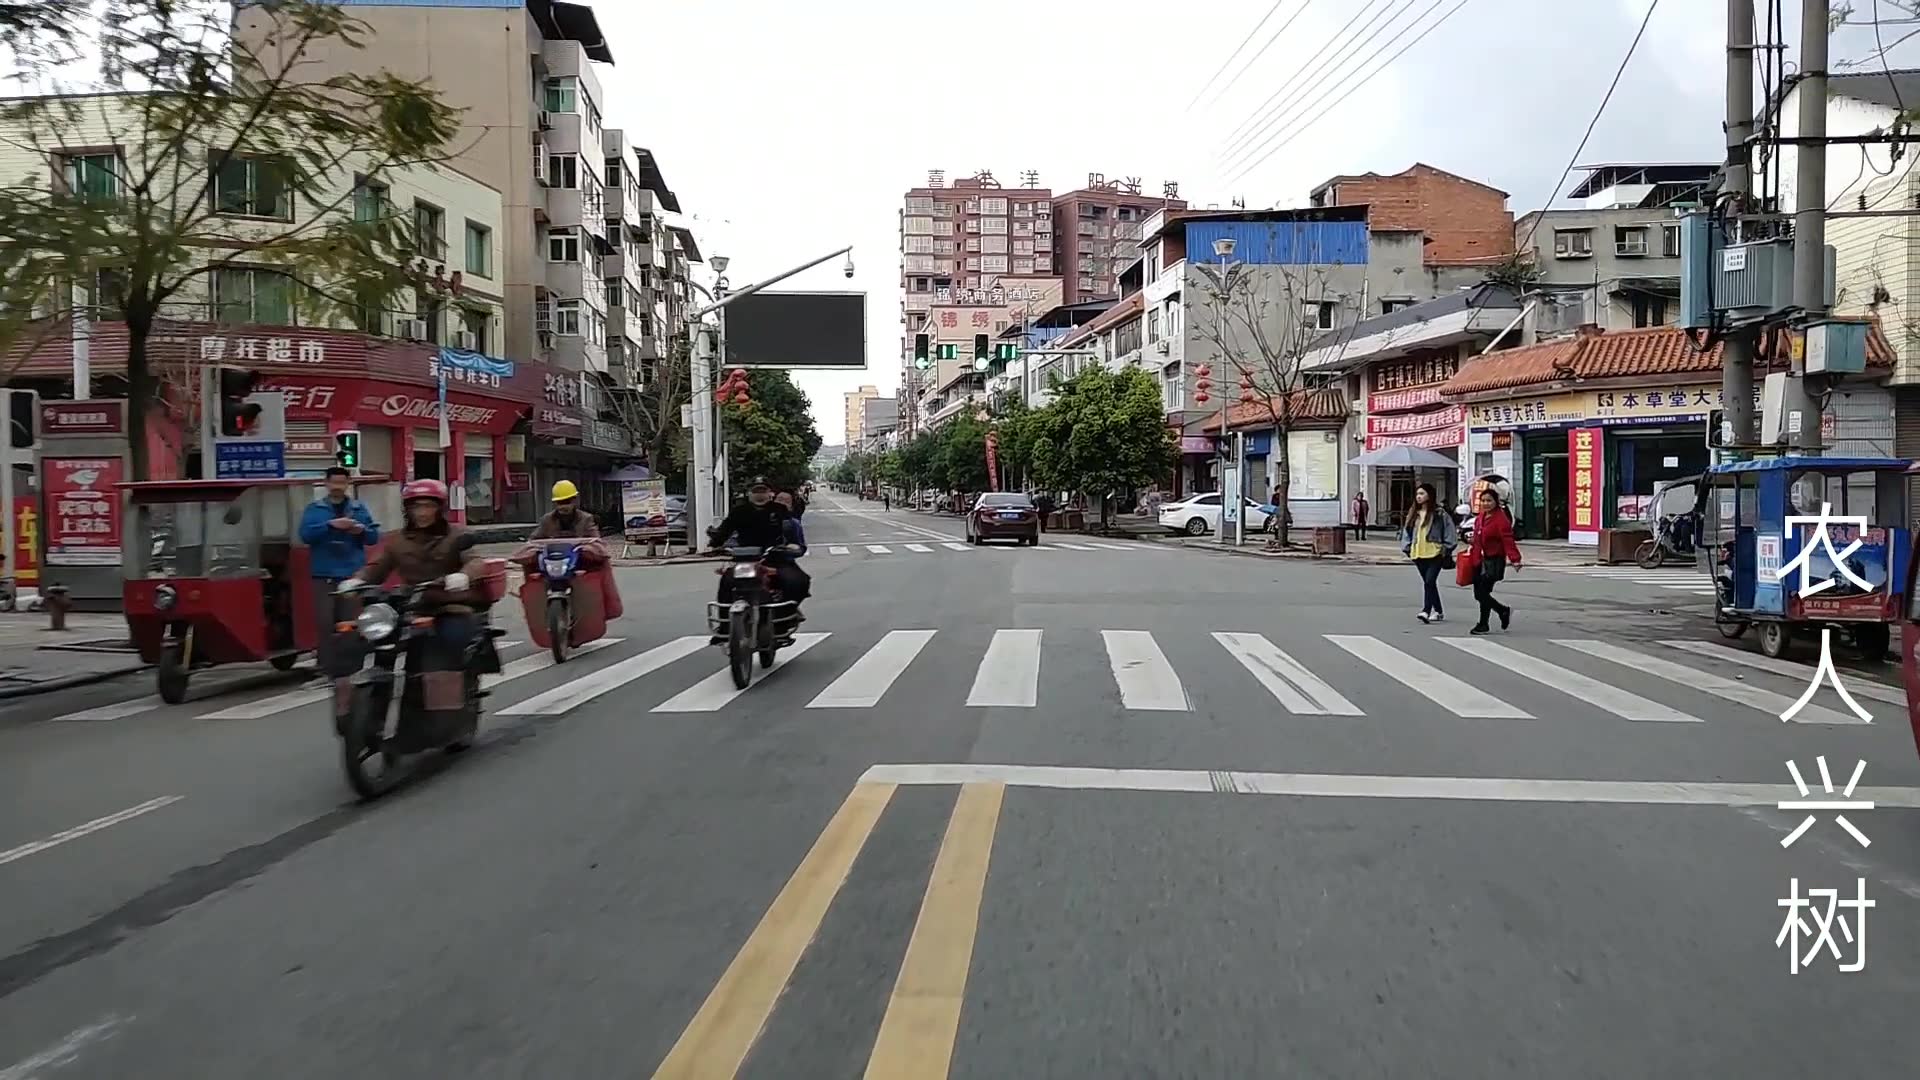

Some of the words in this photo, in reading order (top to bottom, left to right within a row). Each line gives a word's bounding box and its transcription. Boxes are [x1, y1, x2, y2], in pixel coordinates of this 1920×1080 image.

[1088, 172, 1179, 199] 阳光城
[937, 288, 1039, 301] 锦绣商务酒店
[201, 336, 324, 362] 摩托超市
[1483, 401, 1546, 424] 本草堂大药房
